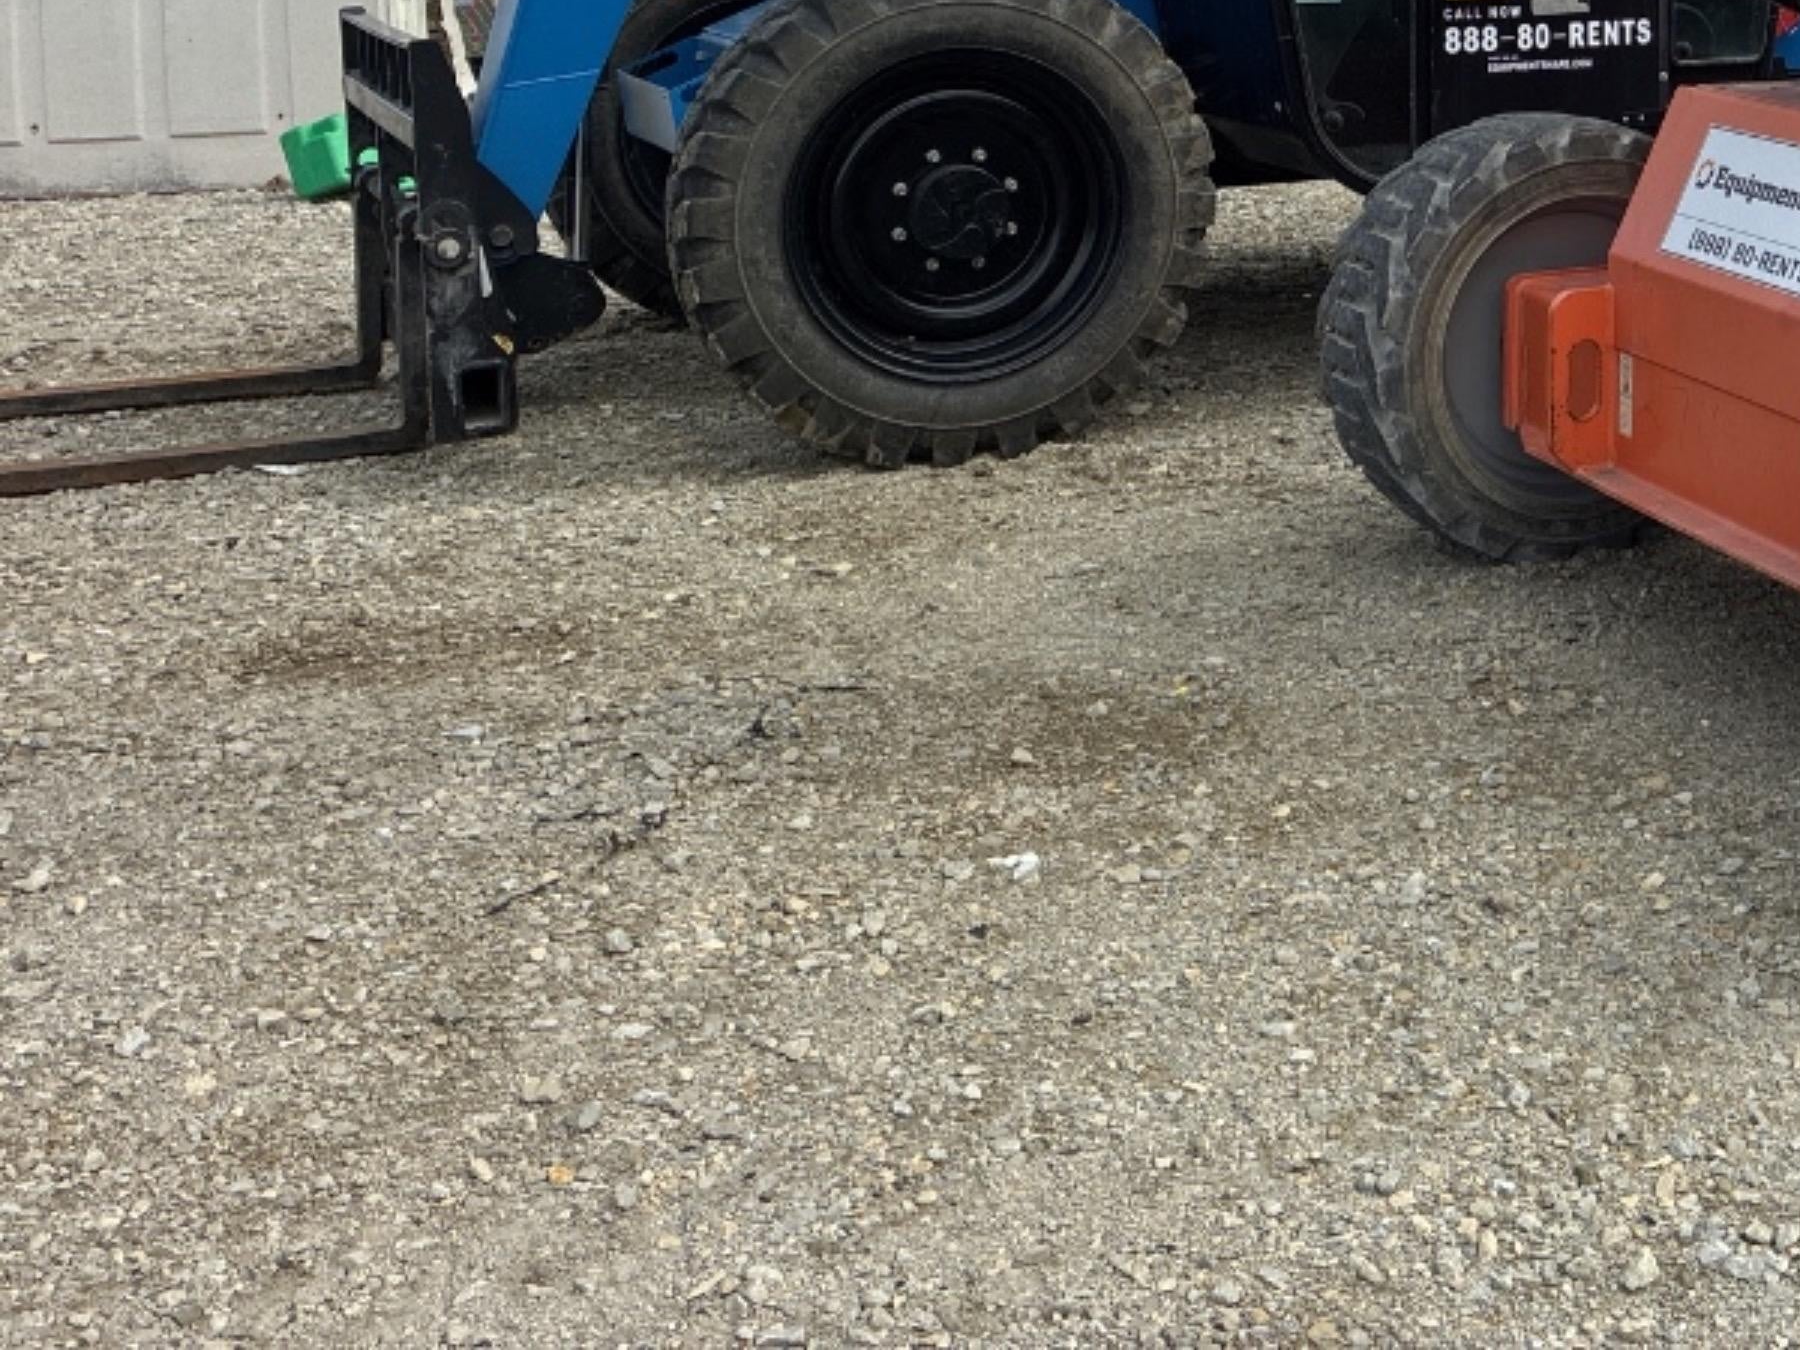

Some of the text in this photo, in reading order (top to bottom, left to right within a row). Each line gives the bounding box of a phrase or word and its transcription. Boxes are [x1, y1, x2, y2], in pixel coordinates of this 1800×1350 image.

[1442, 4, 1522, 21] CALL NOW
[1444, 17, 1652, 54] 888-80-RENTS
[1688, 228, 1731, 260] (888)
